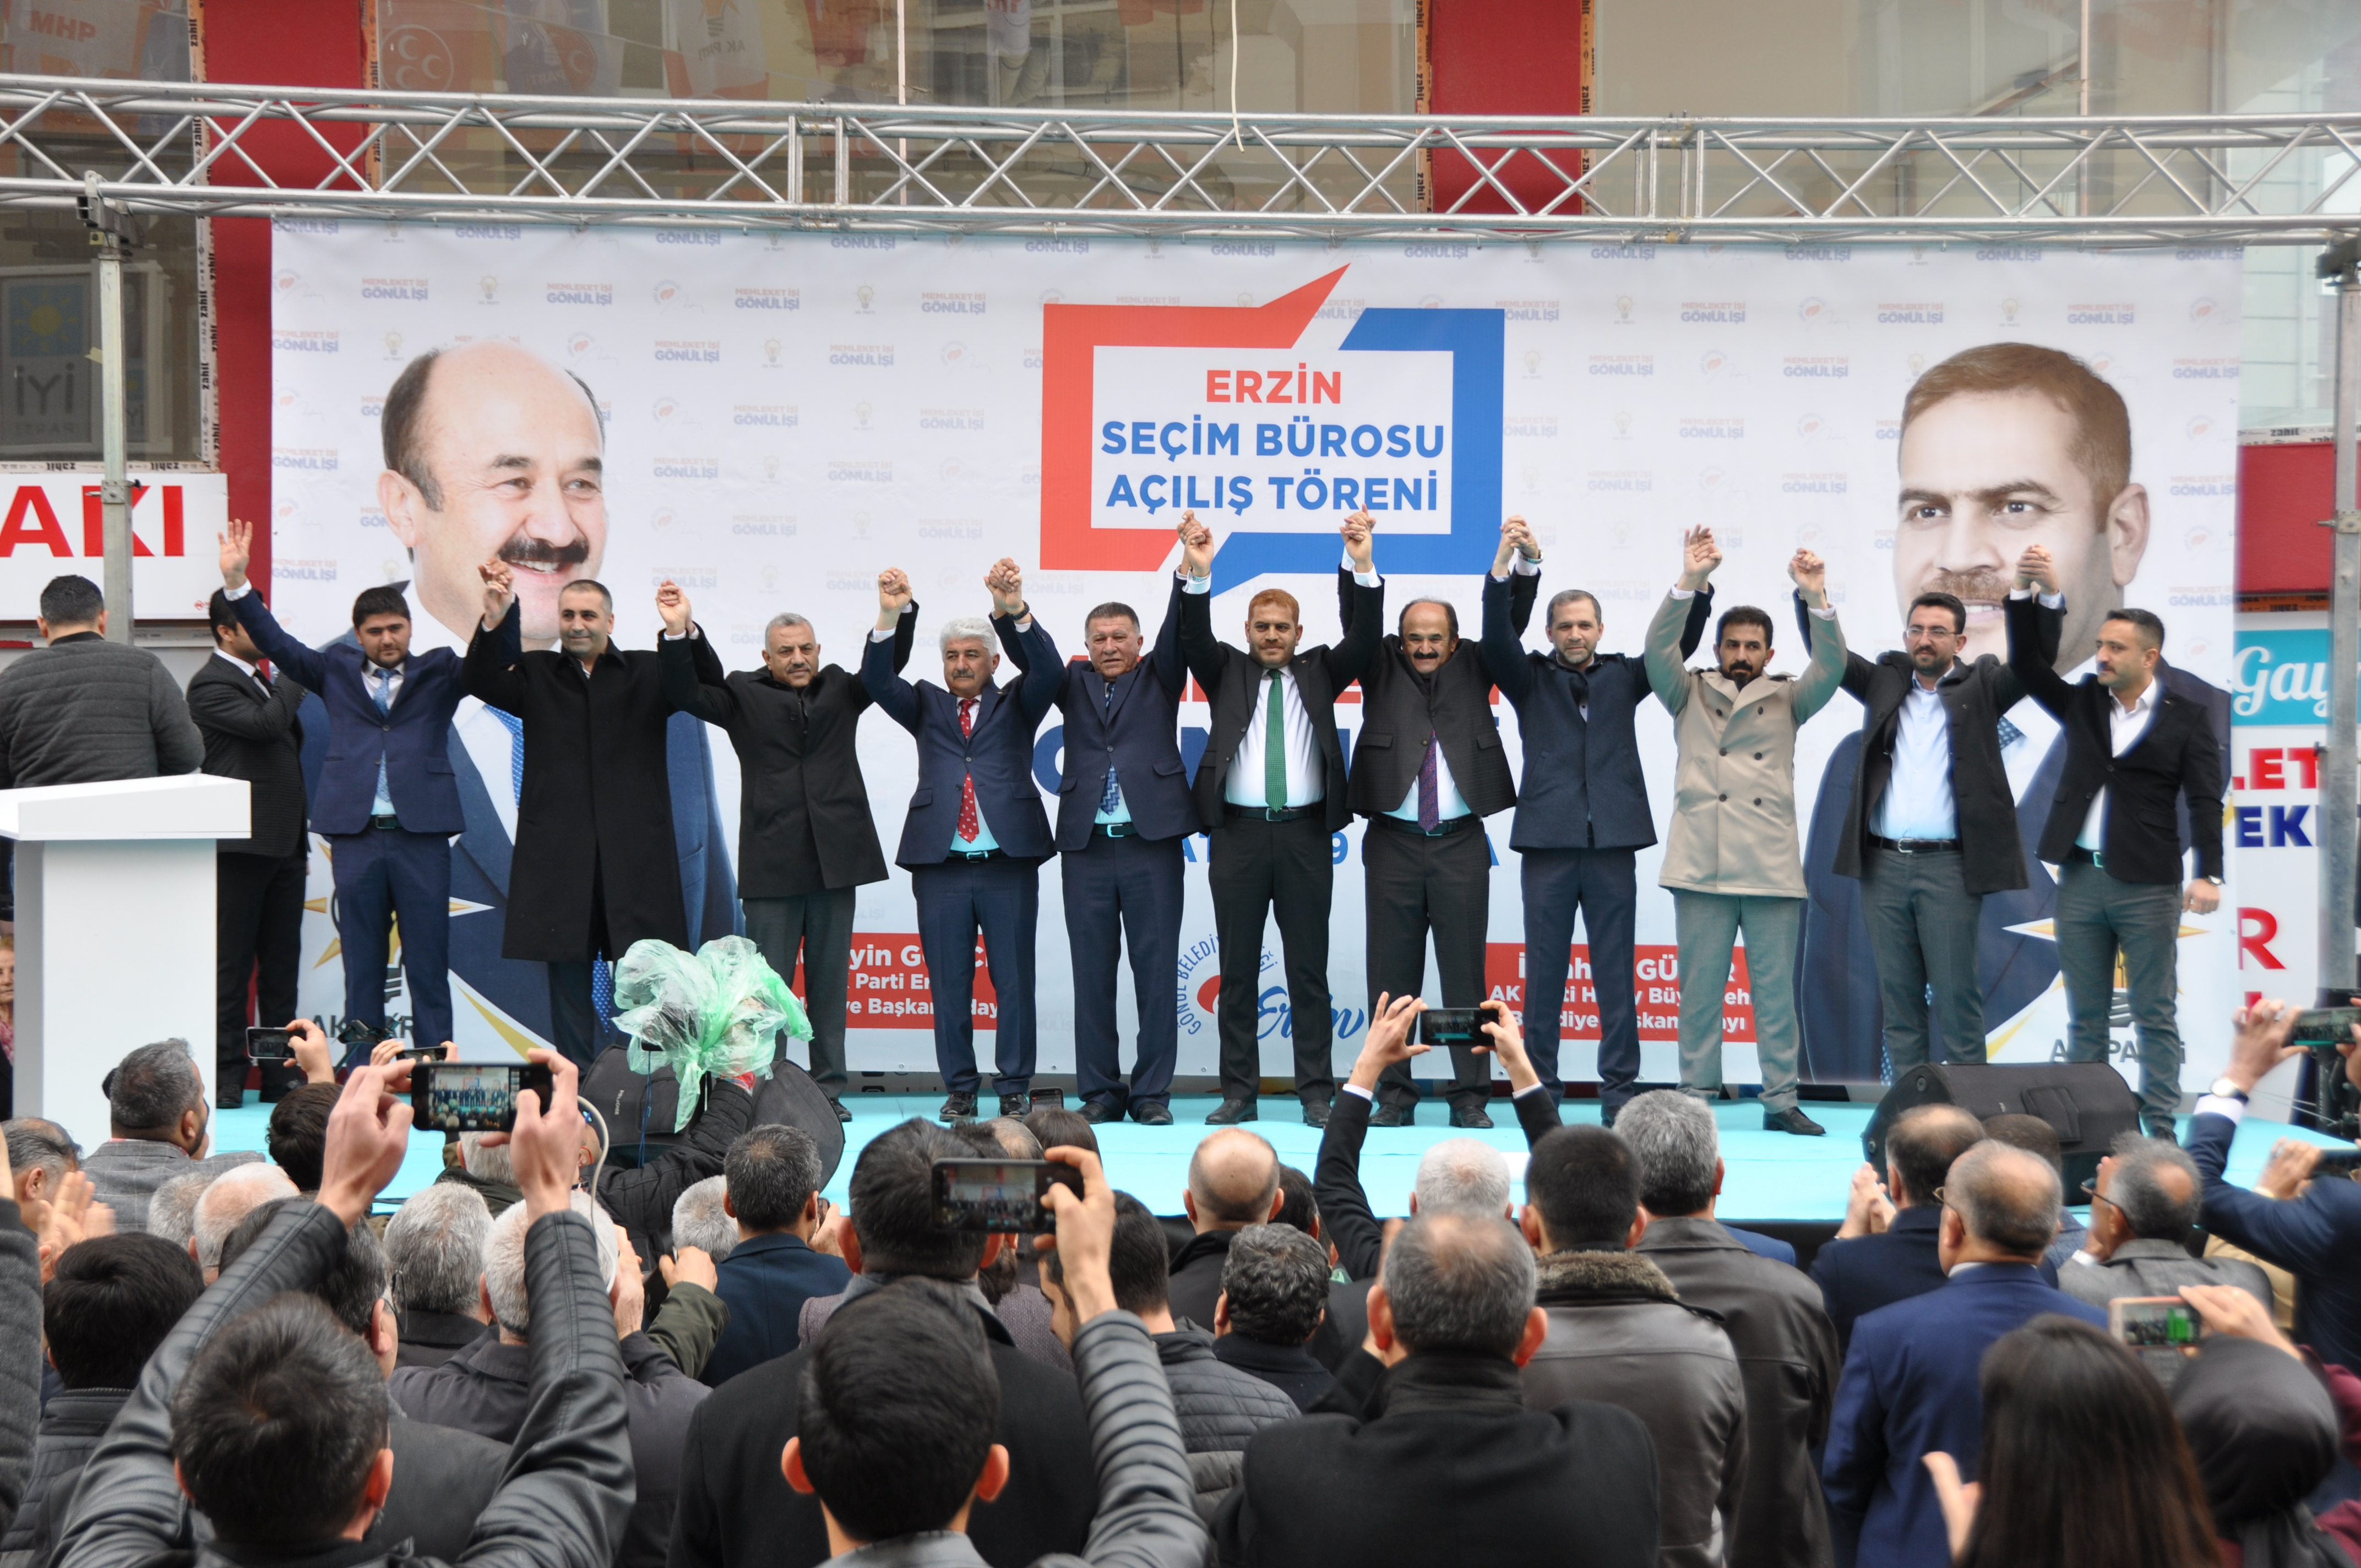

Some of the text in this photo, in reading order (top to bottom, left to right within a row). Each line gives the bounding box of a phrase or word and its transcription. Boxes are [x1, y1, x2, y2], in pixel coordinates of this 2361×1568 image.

[30, 10, 96, 42] MHP
[362, 286, 428, 302] GÖNÜL İŞİ
[547, 291, 612, 307] GÖNÜL İŞİ
[735, 296, 800, 312] GÖNÜL İŞİ
[921, 301, 986, 316] GÖNÜL İŞİ
[1681, 310, 1746, 325] GÖNÜL İŞİ
[1877, 311, 1944, 326] GÖNÜL İŞİ
[654, 349, 720, 364] GÖNÜL İŞİ
[829, 353, 894, 368] GÖNÜL İŞİ
[1588, 363, 1653, 378] GÖNÜL İŞİ
[1783, 364, 1848, 380] GÖNÜL İŞİ
[1206, 362, 1341, 404] ERZİN
[1101, 415, 1444, 462] SEÇİM BÜROSU
[1106, 468, 1438, 516] AÇILIŞ TÖRENİ
[855, 973, 905, 990] Parti
[1489, 985, 1521, 1001] AK
